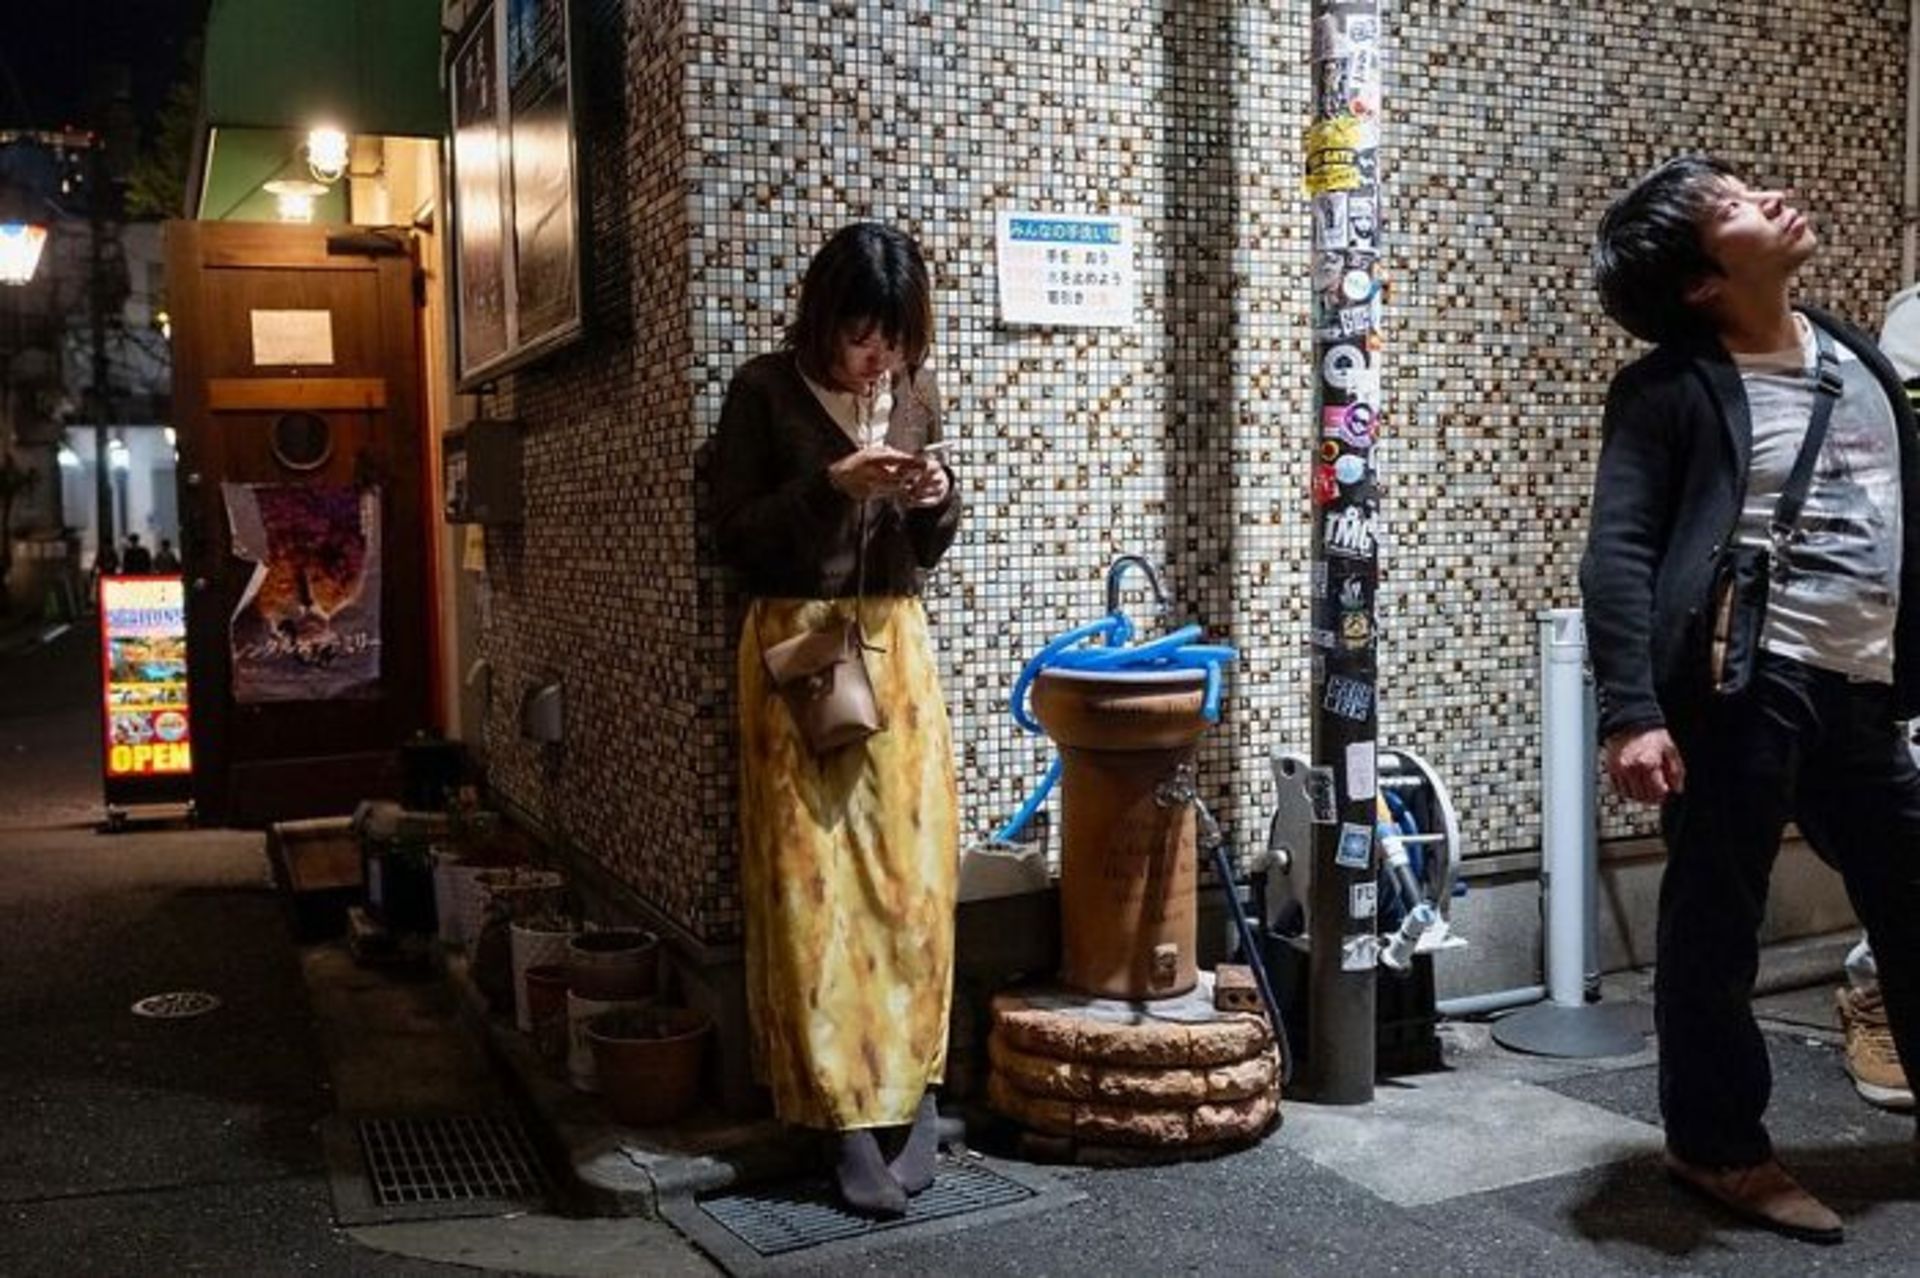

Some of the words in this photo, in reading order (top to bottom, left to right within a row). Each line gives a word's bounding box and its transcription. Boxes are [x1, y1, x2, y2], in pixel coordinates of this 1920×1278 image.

[1046, 249, 1109, 265] 手をおう
[110, 744, 191, 773] OPEN
